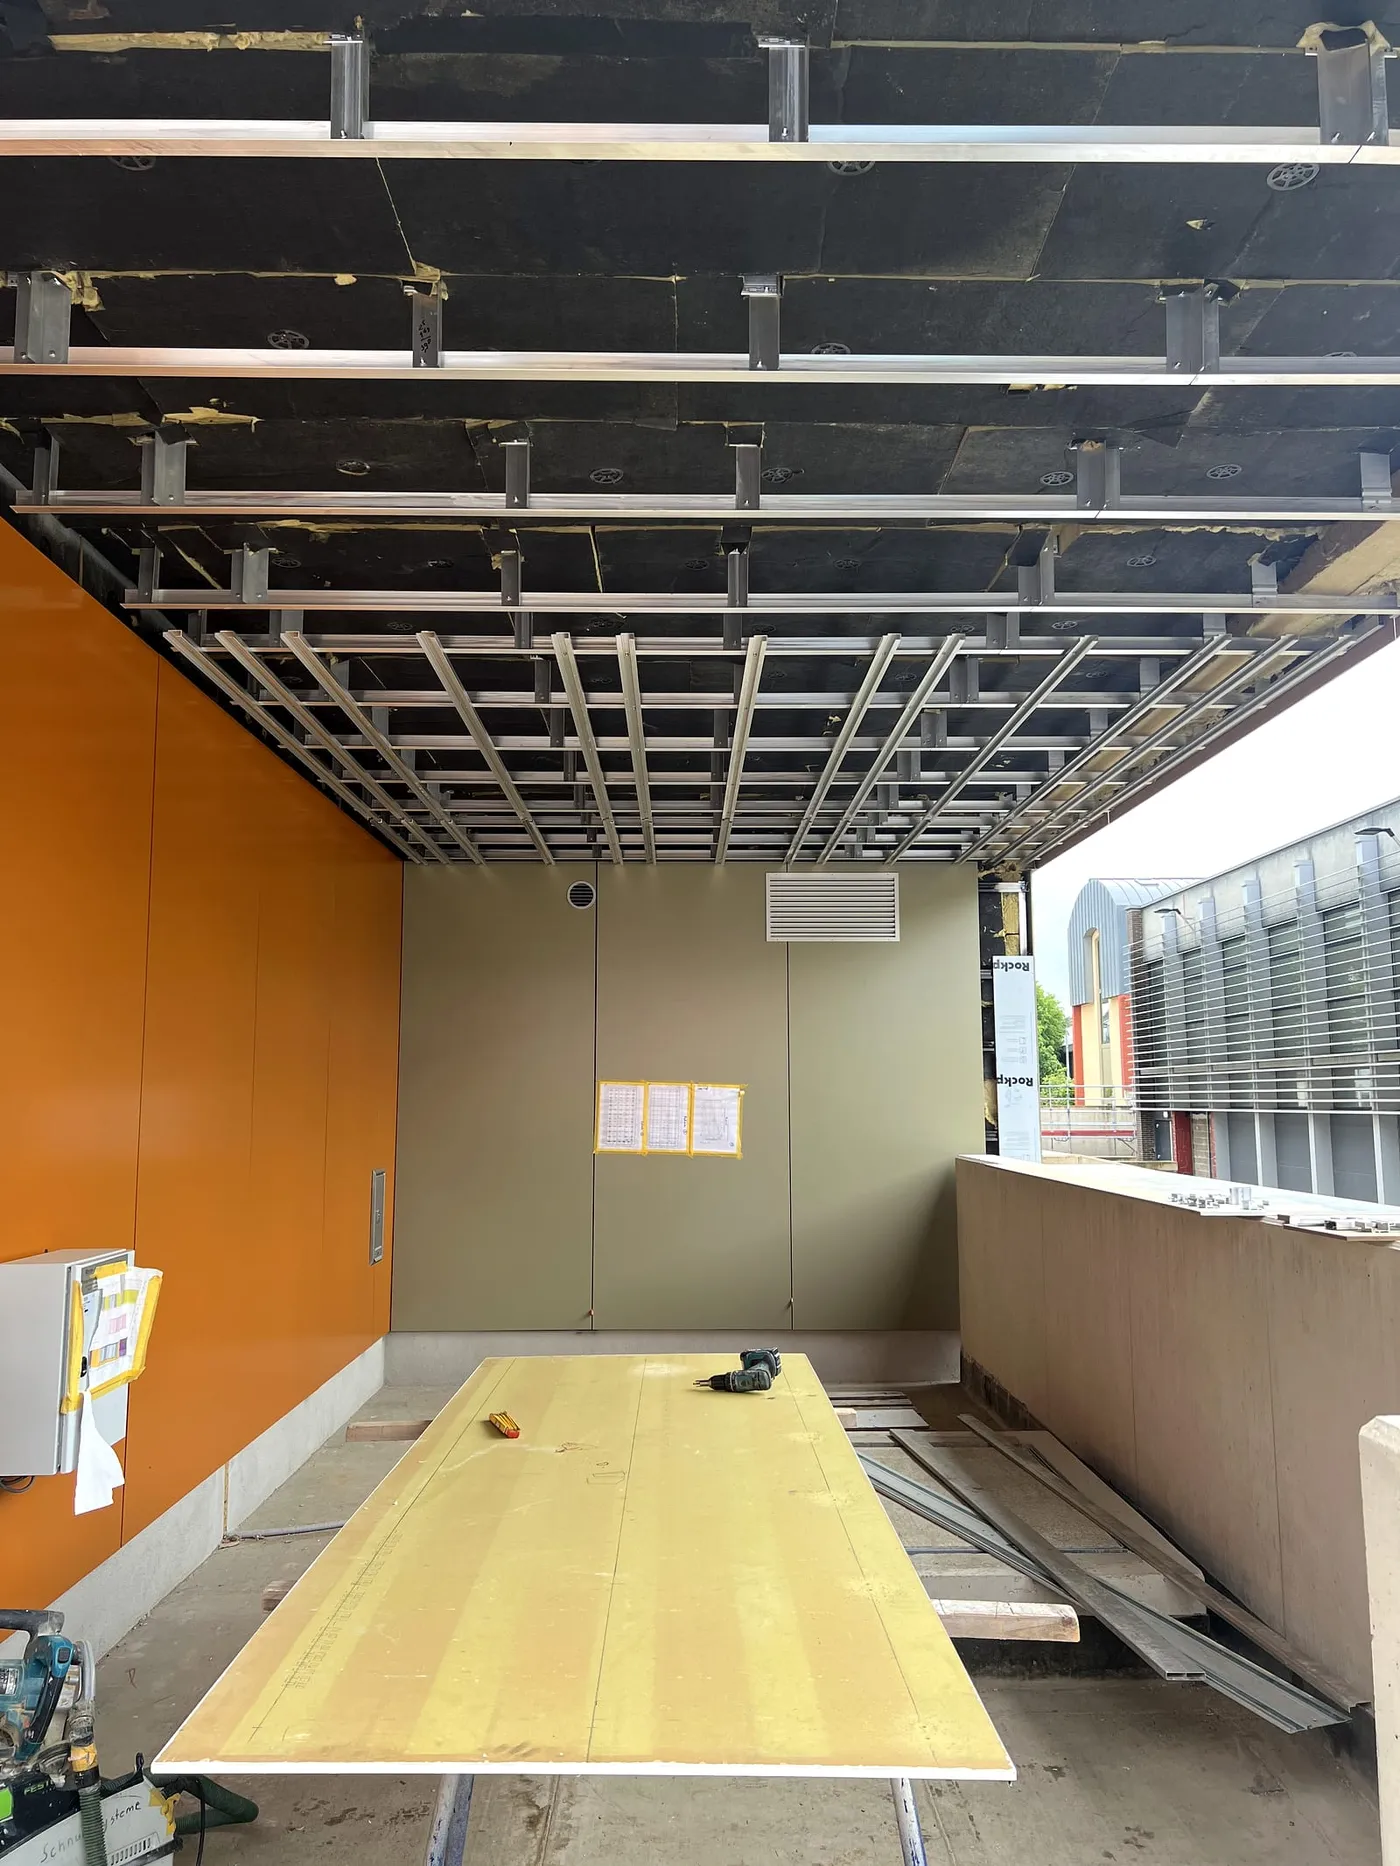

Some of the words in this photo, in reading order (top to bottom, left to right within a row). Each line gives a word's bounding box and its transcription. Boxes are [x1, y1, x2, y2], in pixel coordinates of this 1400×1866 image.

[993, 959, 1030, 972] Rockp
[996, 1074, 1034, 1087] Rockp
[40, 1834, 83, 1864] Schnu
[102, 1800, 142, 1833] ysteme
